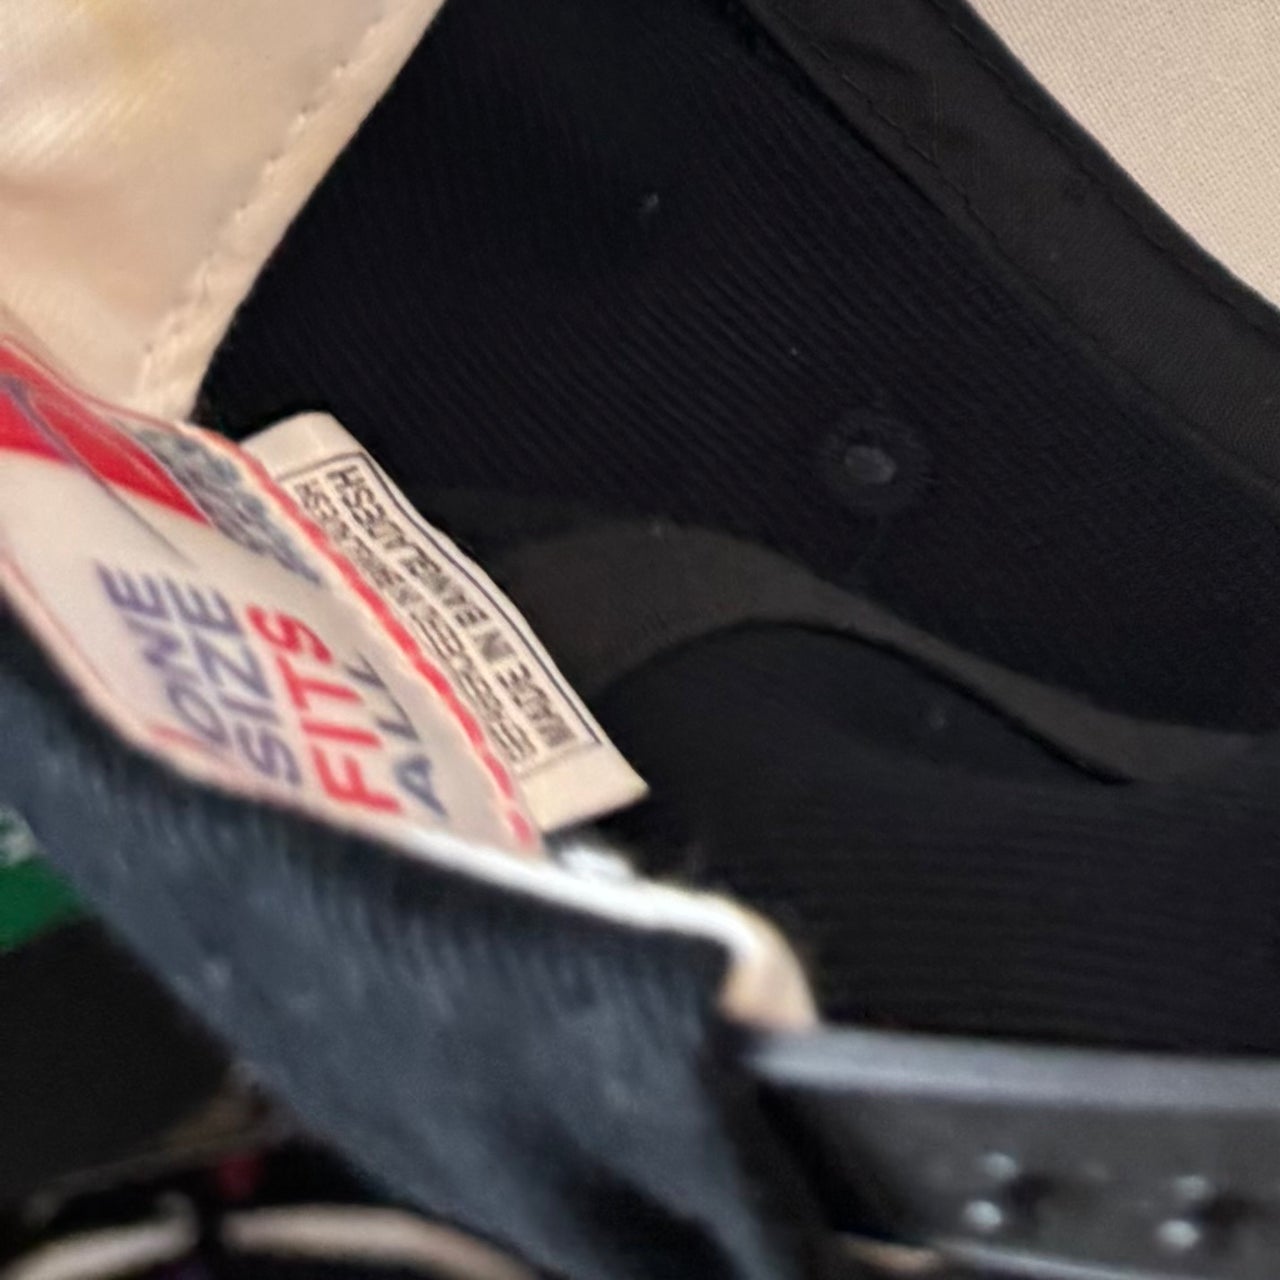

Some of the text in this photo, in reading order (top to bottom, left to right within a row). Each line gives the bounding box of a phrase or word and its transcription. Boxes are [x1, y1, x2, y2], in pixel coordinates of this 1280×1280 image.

[325, 463, 490, 630] BANGLADESH
[97, 558, 230, 750] ONE
[172, 580, 302, 786] SIZE
[248, 603, 403, 815] FITS
[345, 648, 450, 820] ALL
[496, 662, 579, 748] MADE
